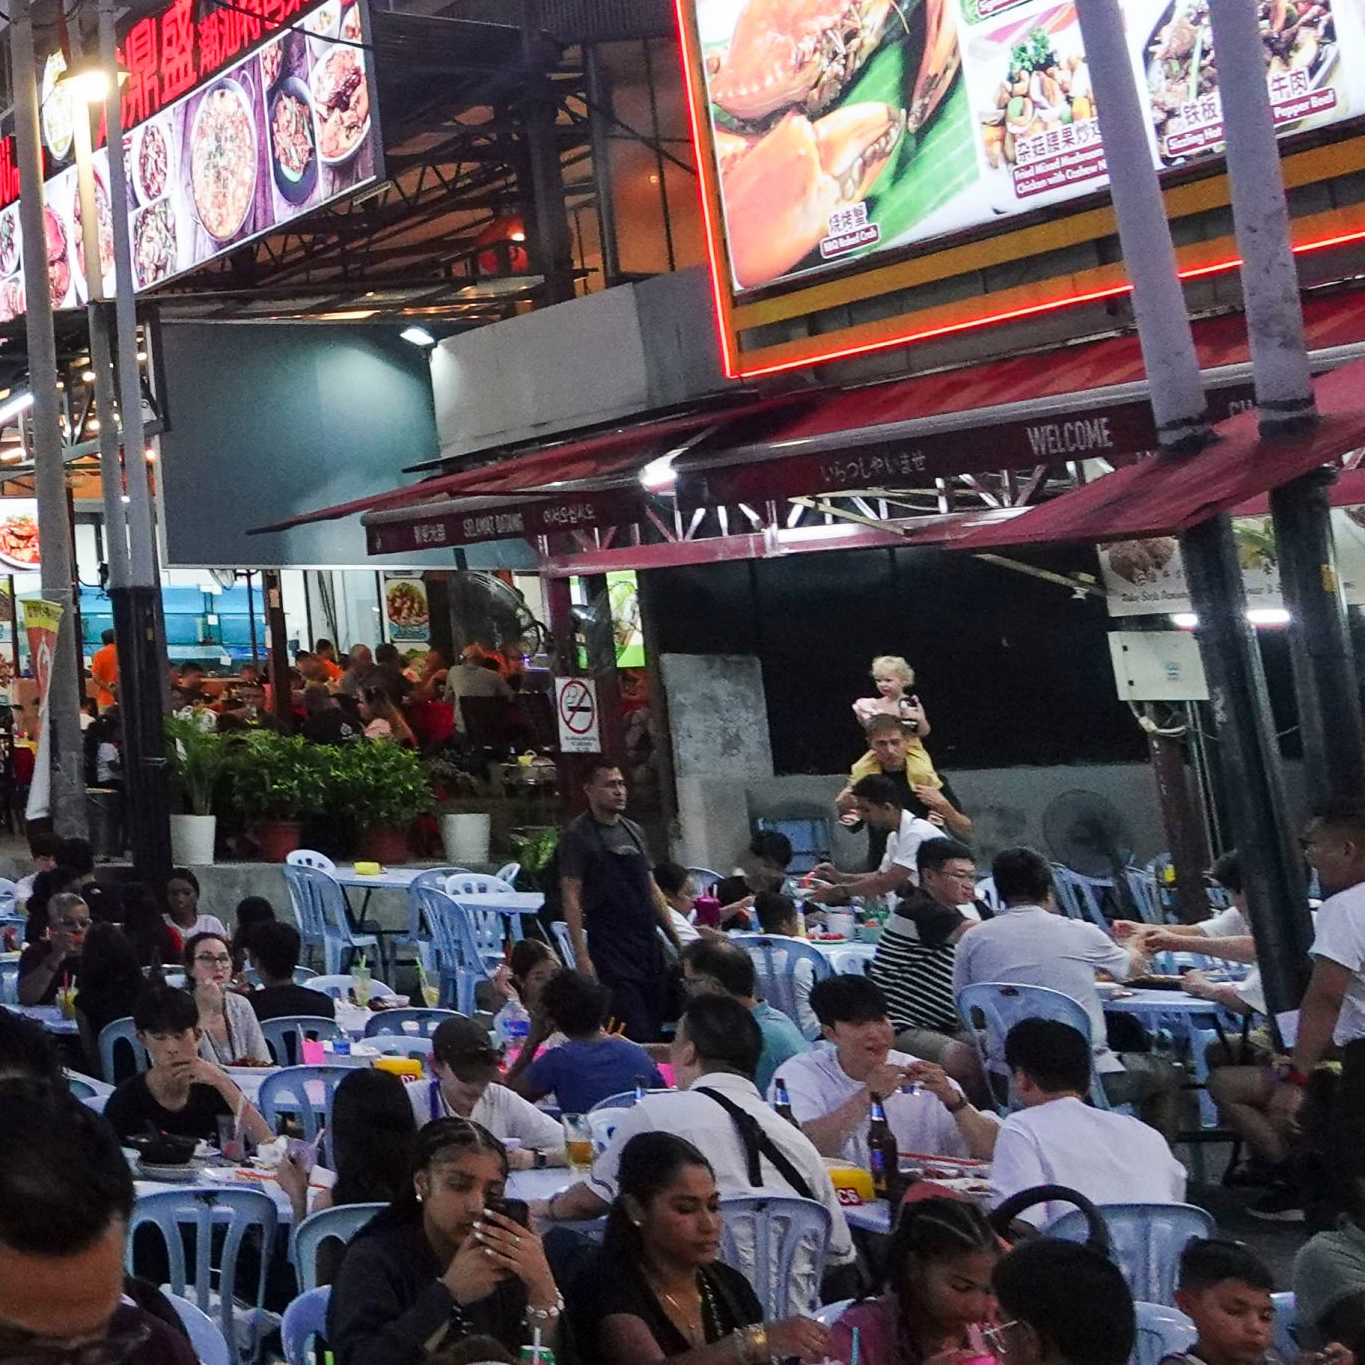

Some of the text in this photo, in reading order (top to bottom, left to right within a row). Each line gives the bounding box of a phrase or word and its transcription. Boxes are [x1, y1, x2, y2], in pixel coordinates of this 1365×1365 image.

[1274, 100, 1310, 119] Pepper
[1310, 91, 1335, 108] Beef
[1026, 417, 1114, 456] WELCOME
[836, 1188, 860, 1204] C6
